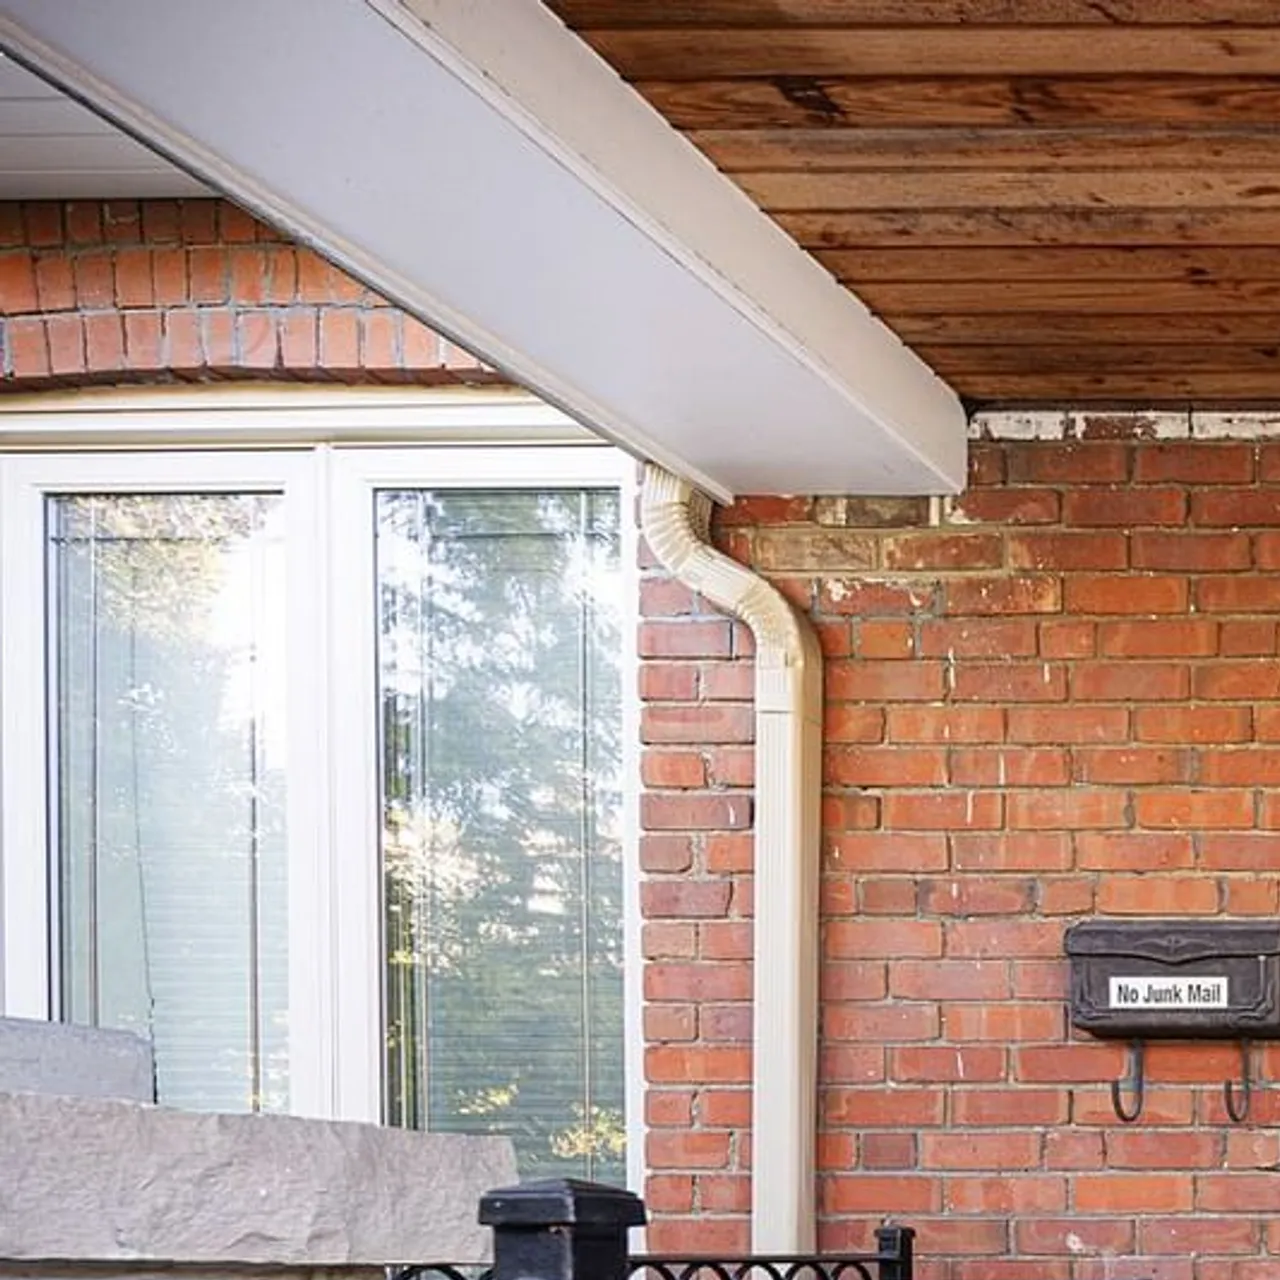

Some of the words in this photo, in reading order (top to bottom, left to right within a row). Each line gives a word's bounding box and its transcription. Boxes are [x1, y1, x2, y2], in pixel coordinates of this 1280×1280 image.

[1117, 983, 1139, 1004] No
[1143, 983, 1184, 1004] Junk
[1187, 983, 1221, 1004] Mail
